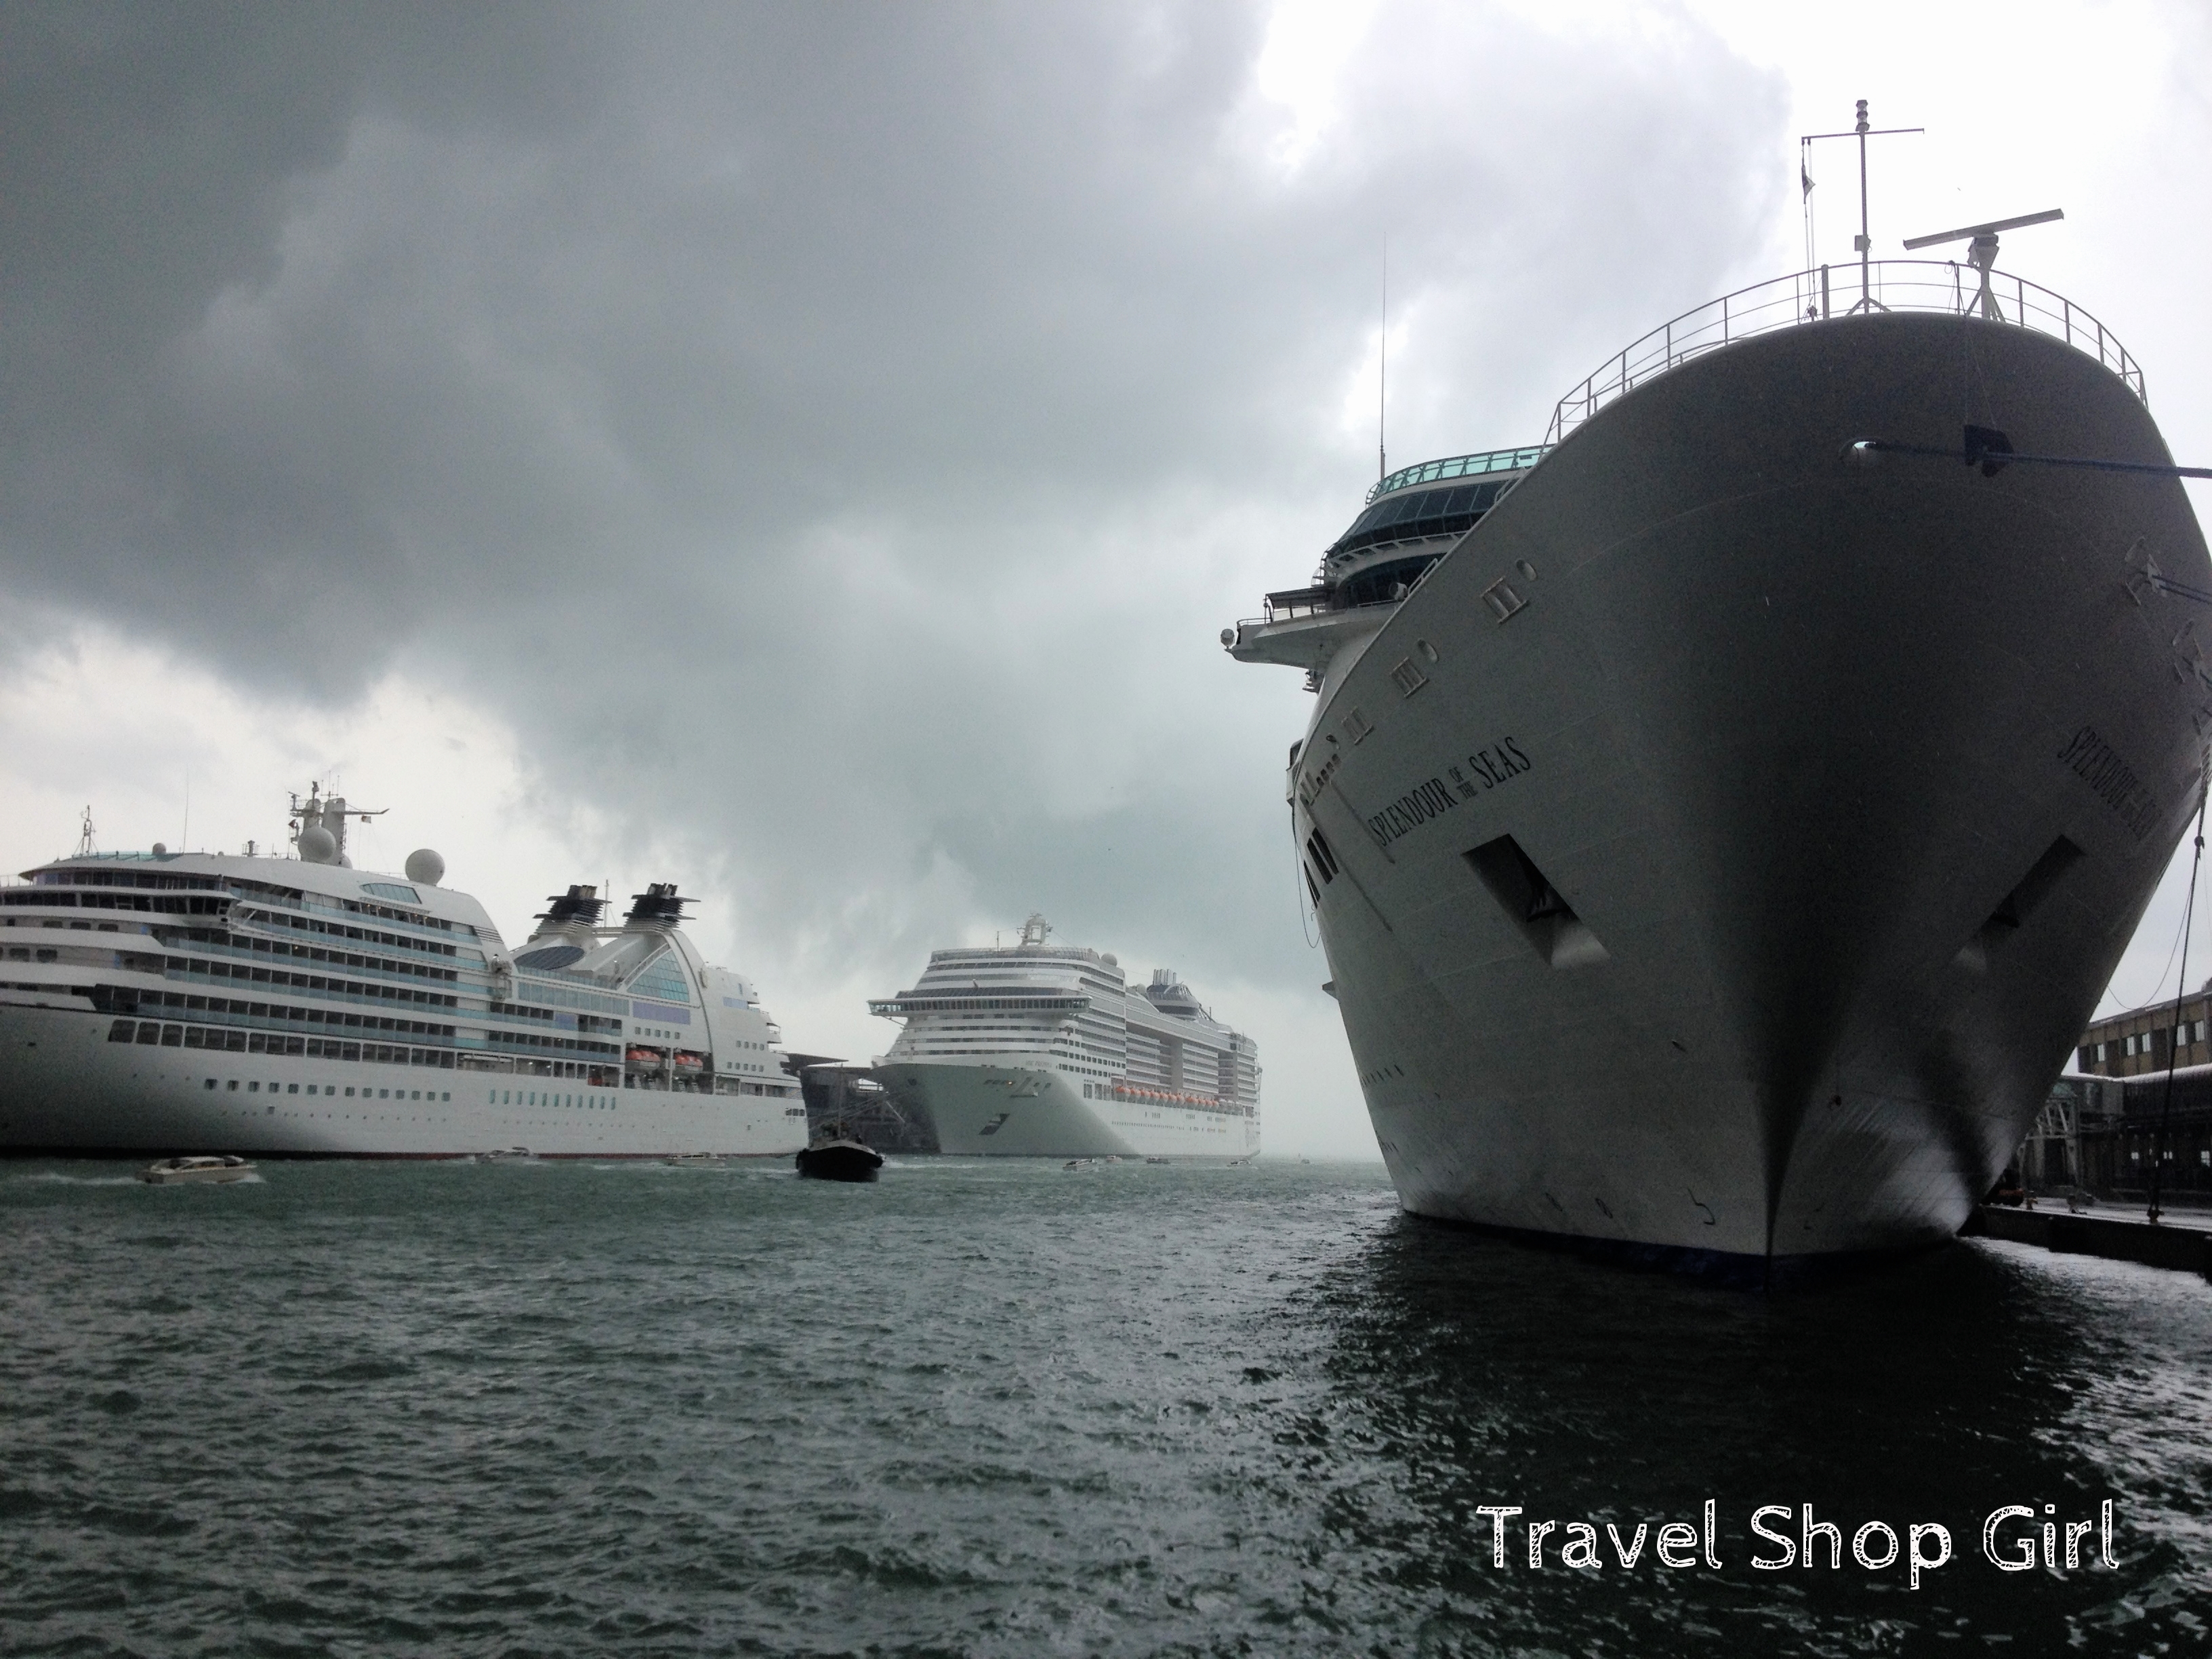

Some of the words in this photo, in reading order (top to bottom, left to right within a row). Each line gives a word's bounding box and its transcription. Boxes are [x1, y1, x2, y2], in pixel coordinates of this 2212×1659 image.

[1368, 777, 1458, 846] SPLENDOUR
[1448, 766, 1465, 783] OF
[1457, 781, 1479, 800] THE
[1469, 736, 1532, 789] SEAS
[2057, 725, 2138, 811] SPLENDOUR
